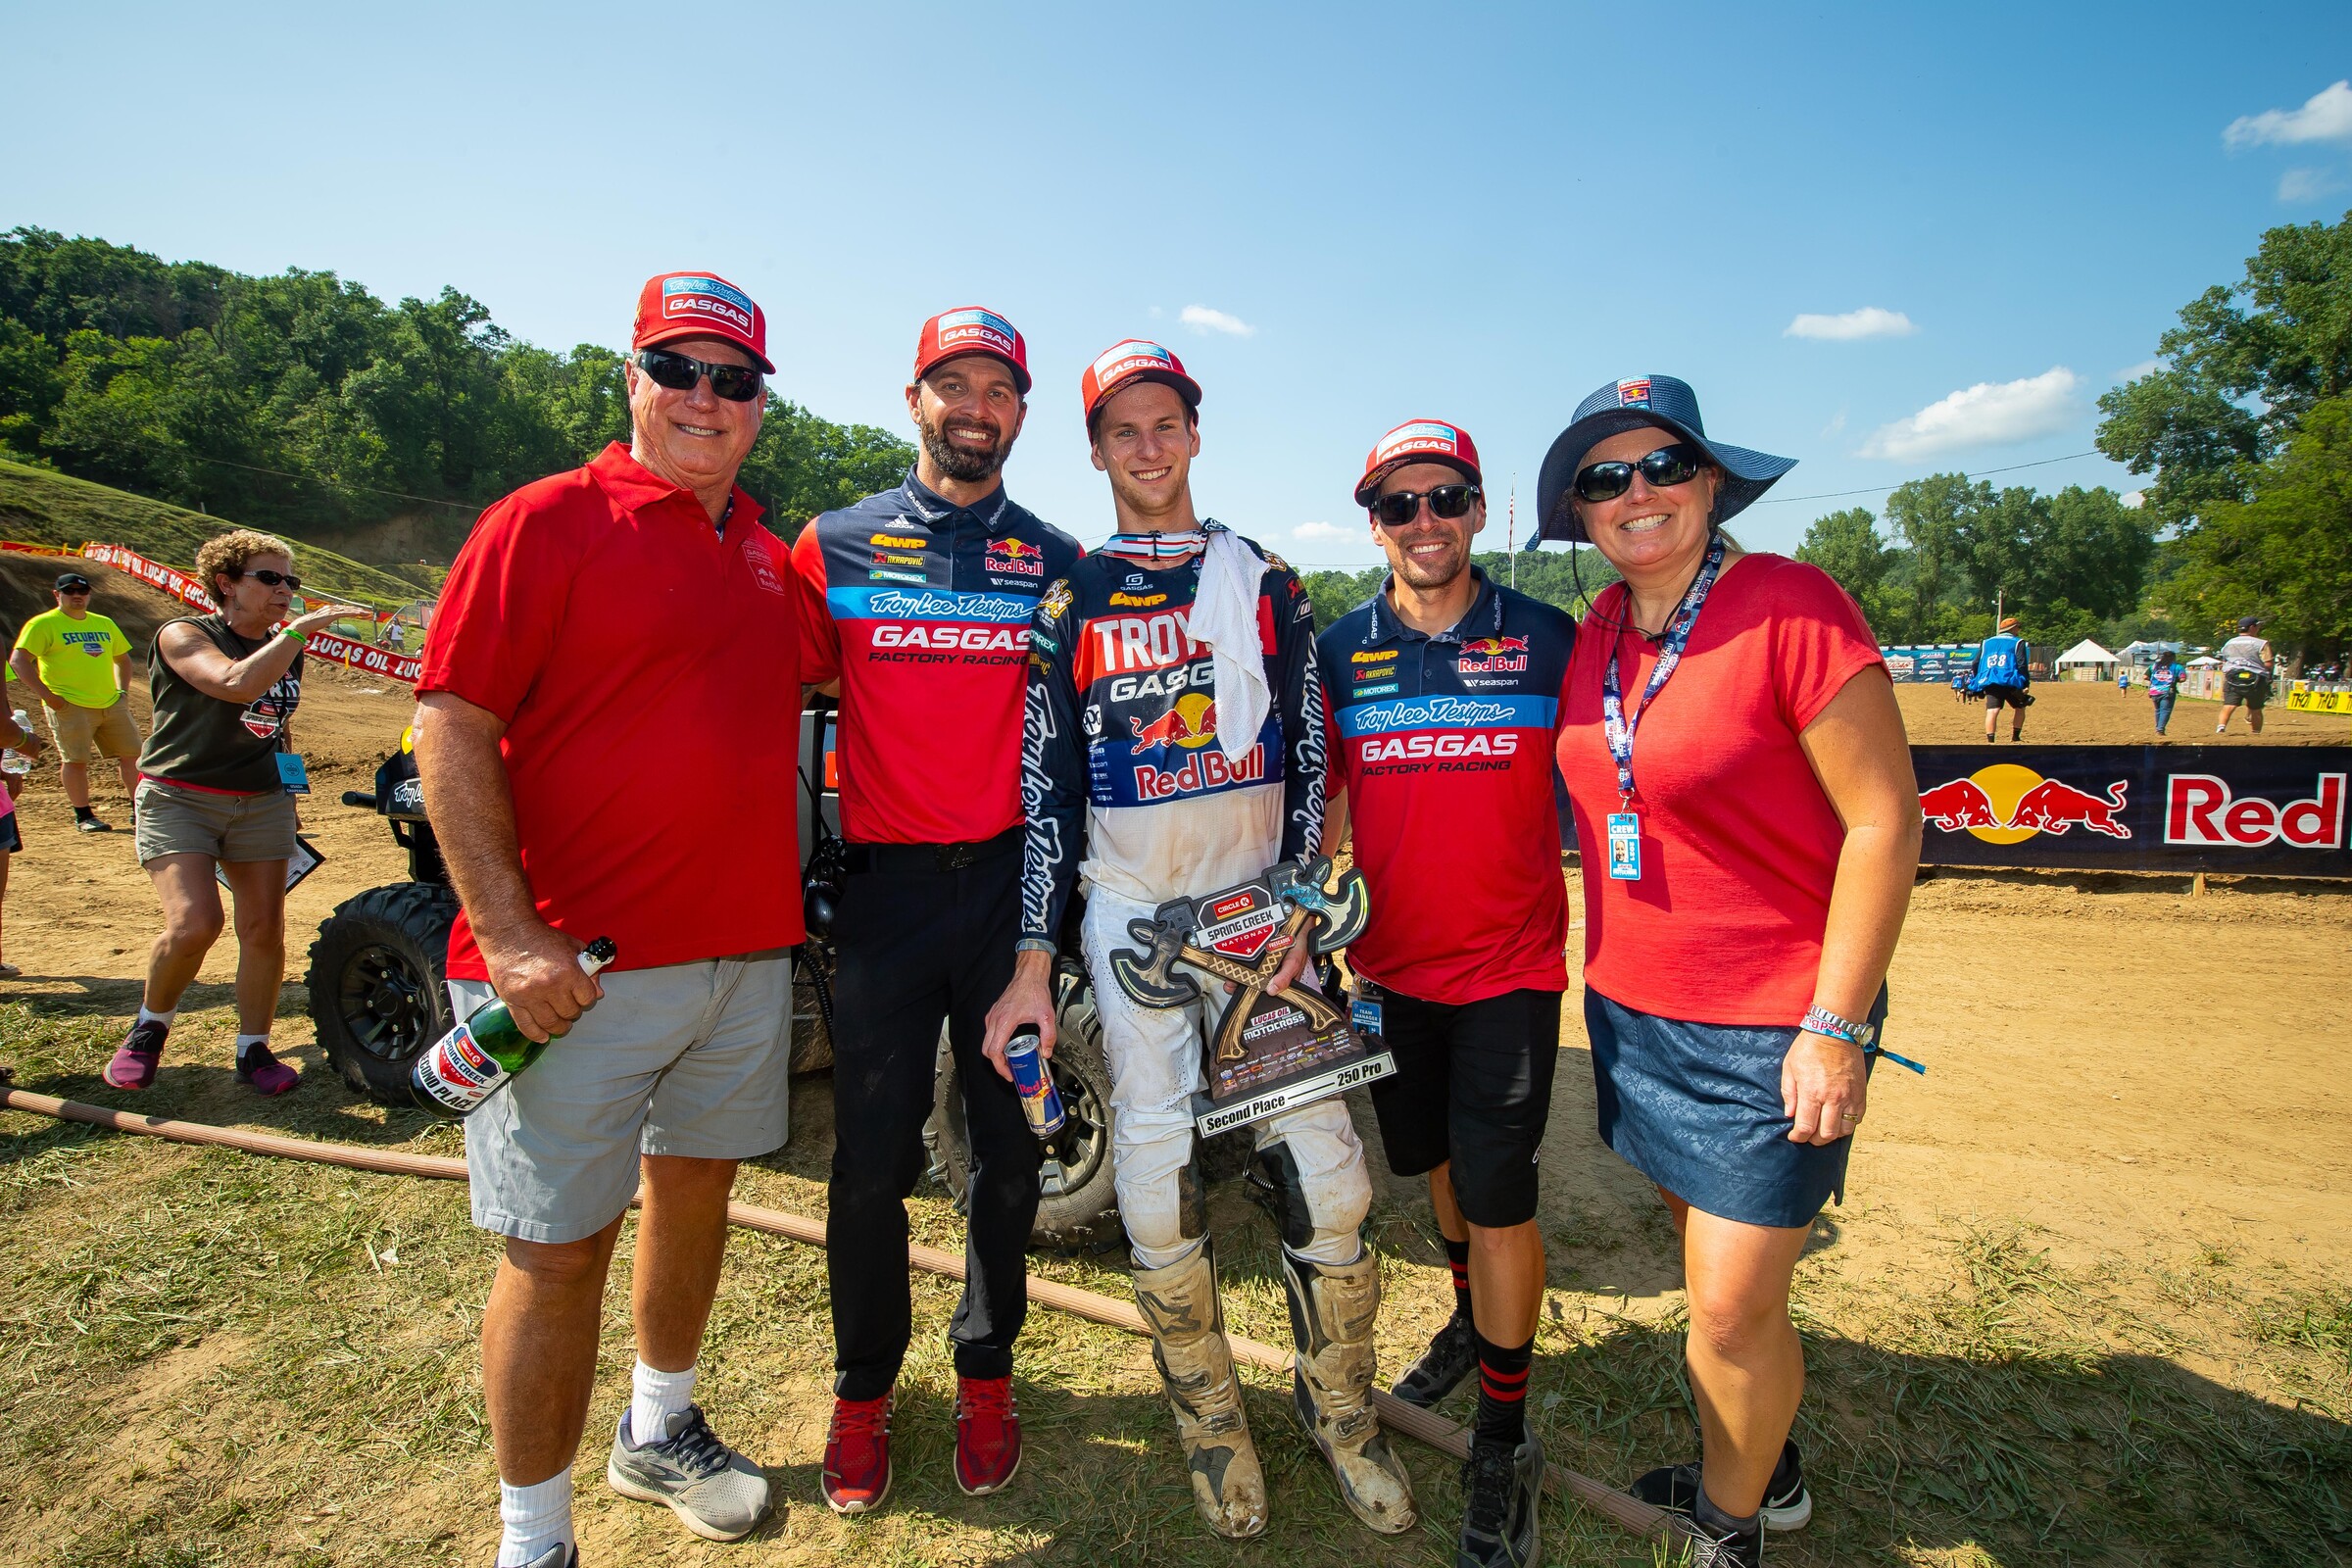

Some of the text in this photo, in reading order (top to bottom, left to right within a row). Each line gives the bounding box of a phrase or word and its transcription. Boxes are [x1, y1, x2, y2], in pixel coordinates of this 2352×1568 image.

[669, 298, 749, 327] GASGAS
[944, 327, 1011, 352] GASGAS
[1102, 359, 1169, 383] GASGAS
[1381, 440, 1451, 462] GASGAS
[883, 572, 924, 582] MOTOREX
[986, 557, 1043, 576] Red Bull
[143, 563, 169, 585] LUCAS
[184, 583, 215, 611] LUCAS
[1004, 579, 1039, 589] seaspan
[870, 591, 916, 617] Troy
[915, 593, 957, 615] Lee
[957, 594, 1037, 621] Designs
[63, 632, 112, 645] SECURITY
[872, 625, 1030, 651] GASGAS
[310, 635, 422, 679] LUCAS OIL LUC
[867, 652, 959, 664] FACTORY
[1458, 655, 1528, 672] Red Bull
[1110, 662, 1214, 703] GASG
[1364, 684, 1396, 696] MOTOREX
[1355, 697, 1516, 732] Troy Lee Designs
[1362, 733, 1519, 762] GASGAS
[1133, 754, 1200, 802] Red
[1201, 742, 1264, 790] Bull
[1438, 760, 1511, 772] RACING
[394, 782, 415, 808] Troy
[2166, 774, 2346, 849] Red
[1611, 825, 1635, 834] CREW
[1020, 817, 1063, 934] Designs
[1218, 902, 1240, 913] CIRCLE
[1207, 910, 1274, 941] SPRING CREEK
[1221, 928, 1268, 948] NATIONAL
[1244, 1013, 1305, 1040] MOTOCROSS
[1254, 1007, 1290, 1025] LUCAS OIL
[1354, 1012, 1378, 1021] MANAGER
[461, 1040, 473, 1057] CIRCLE
[441, 1050, 470, 1086] NATIONAL
[446, 1038, 462, 1065] SPRING
[459, 1063, 487, 1084] CREEK
[433, 1086, 475, 1109] PLACE
[1019, 1080, 1040, 1094] Red
[1205, 1061, 1382, 1131] Second Place 250 Pro
